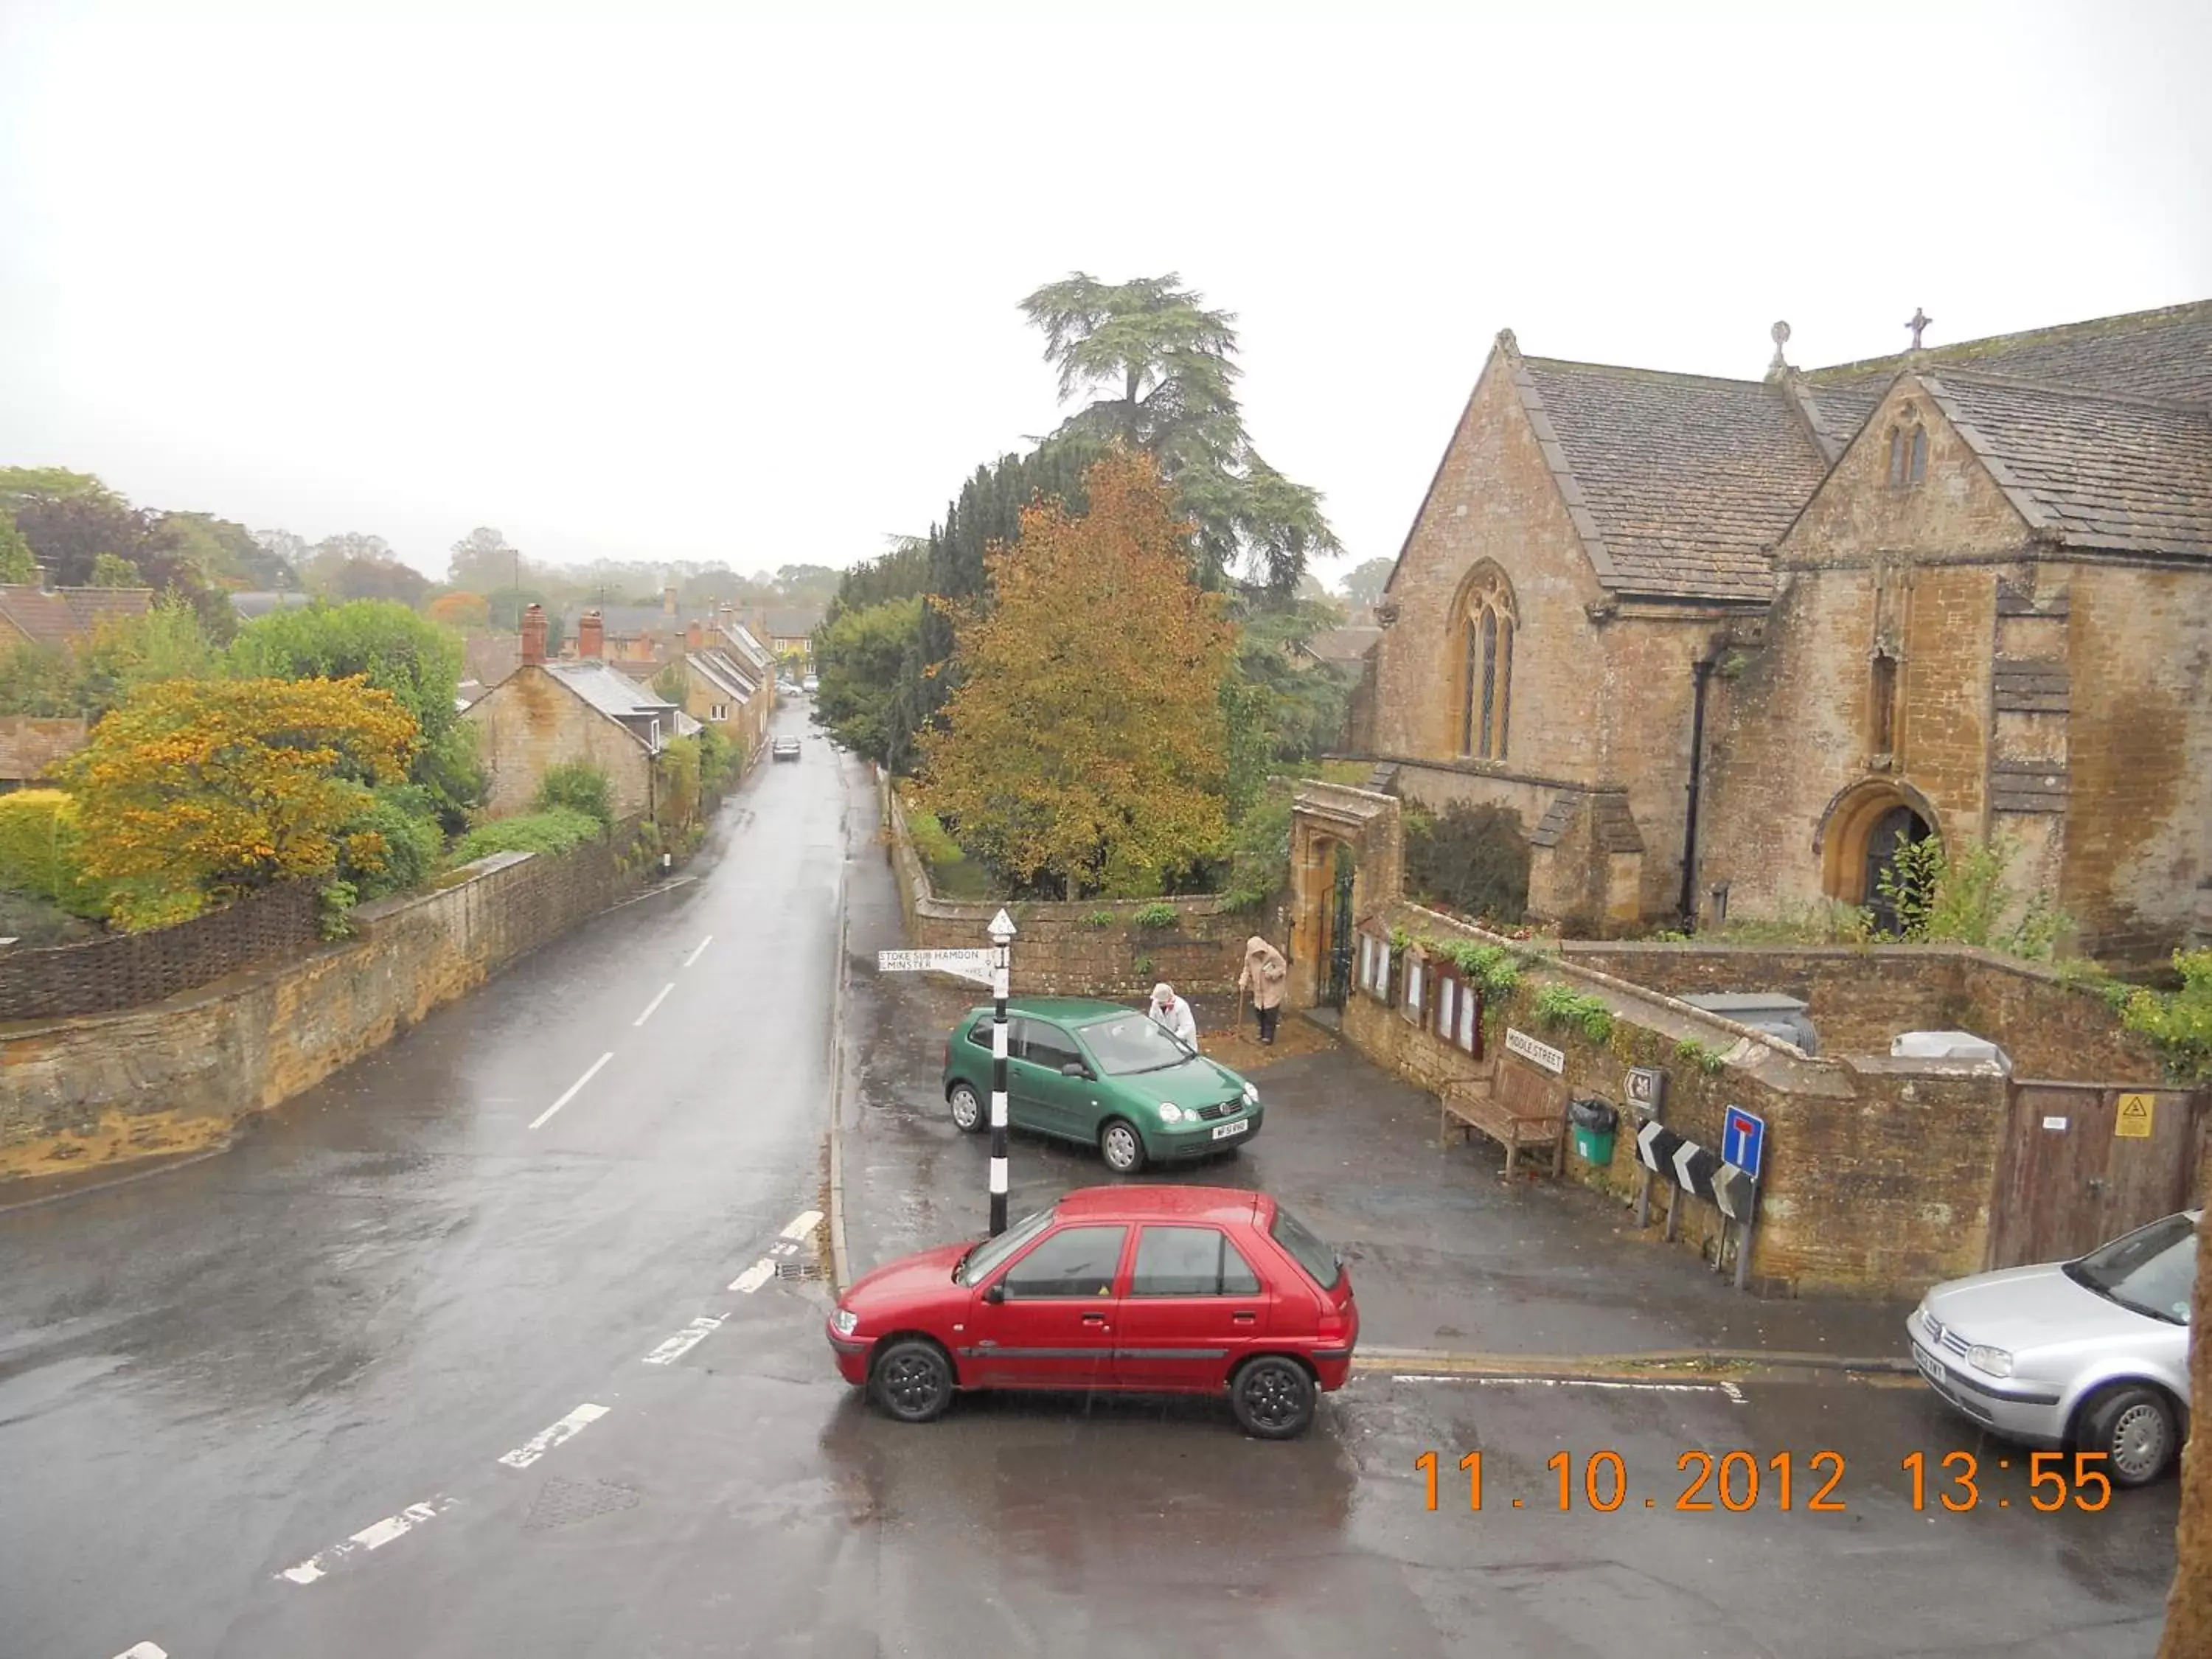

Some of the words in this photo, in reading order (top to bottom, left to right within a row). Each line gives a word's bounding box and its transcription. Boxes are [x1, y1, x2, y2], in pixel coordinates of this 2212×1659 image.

[879, 952, 910, 961] STOKE
[934, 950, 978, 960] HAMDON
[1508, 1032, 1532, 1054] MIDDLE
[1533, 1044, 1562, 1066] STREET
